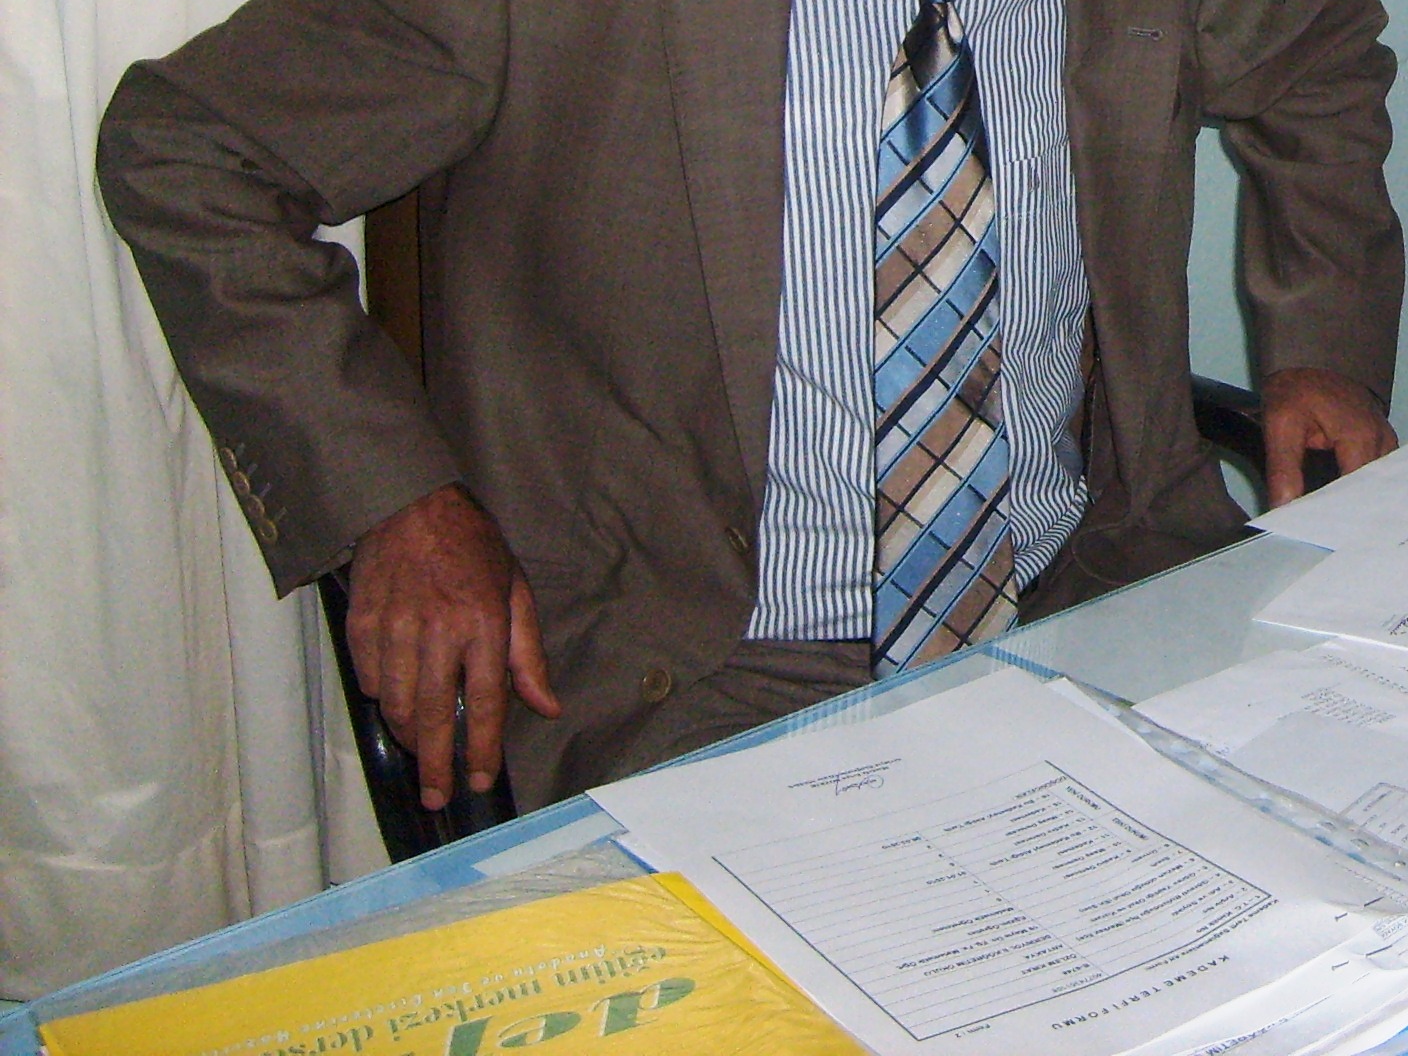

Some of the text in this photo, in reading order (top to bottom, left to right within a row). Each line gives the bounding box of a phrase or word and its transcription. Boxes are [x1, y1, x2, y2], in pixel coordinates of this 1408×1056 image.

[512, 943, 607, 978] Anadolu
[553, 945, 667, 987] eğitim
[1162, 952, 1230, 987] KADEME
[388, 978, 542, 1042] merkezi
[1049, 1005, 1110, 1032] FORMU
